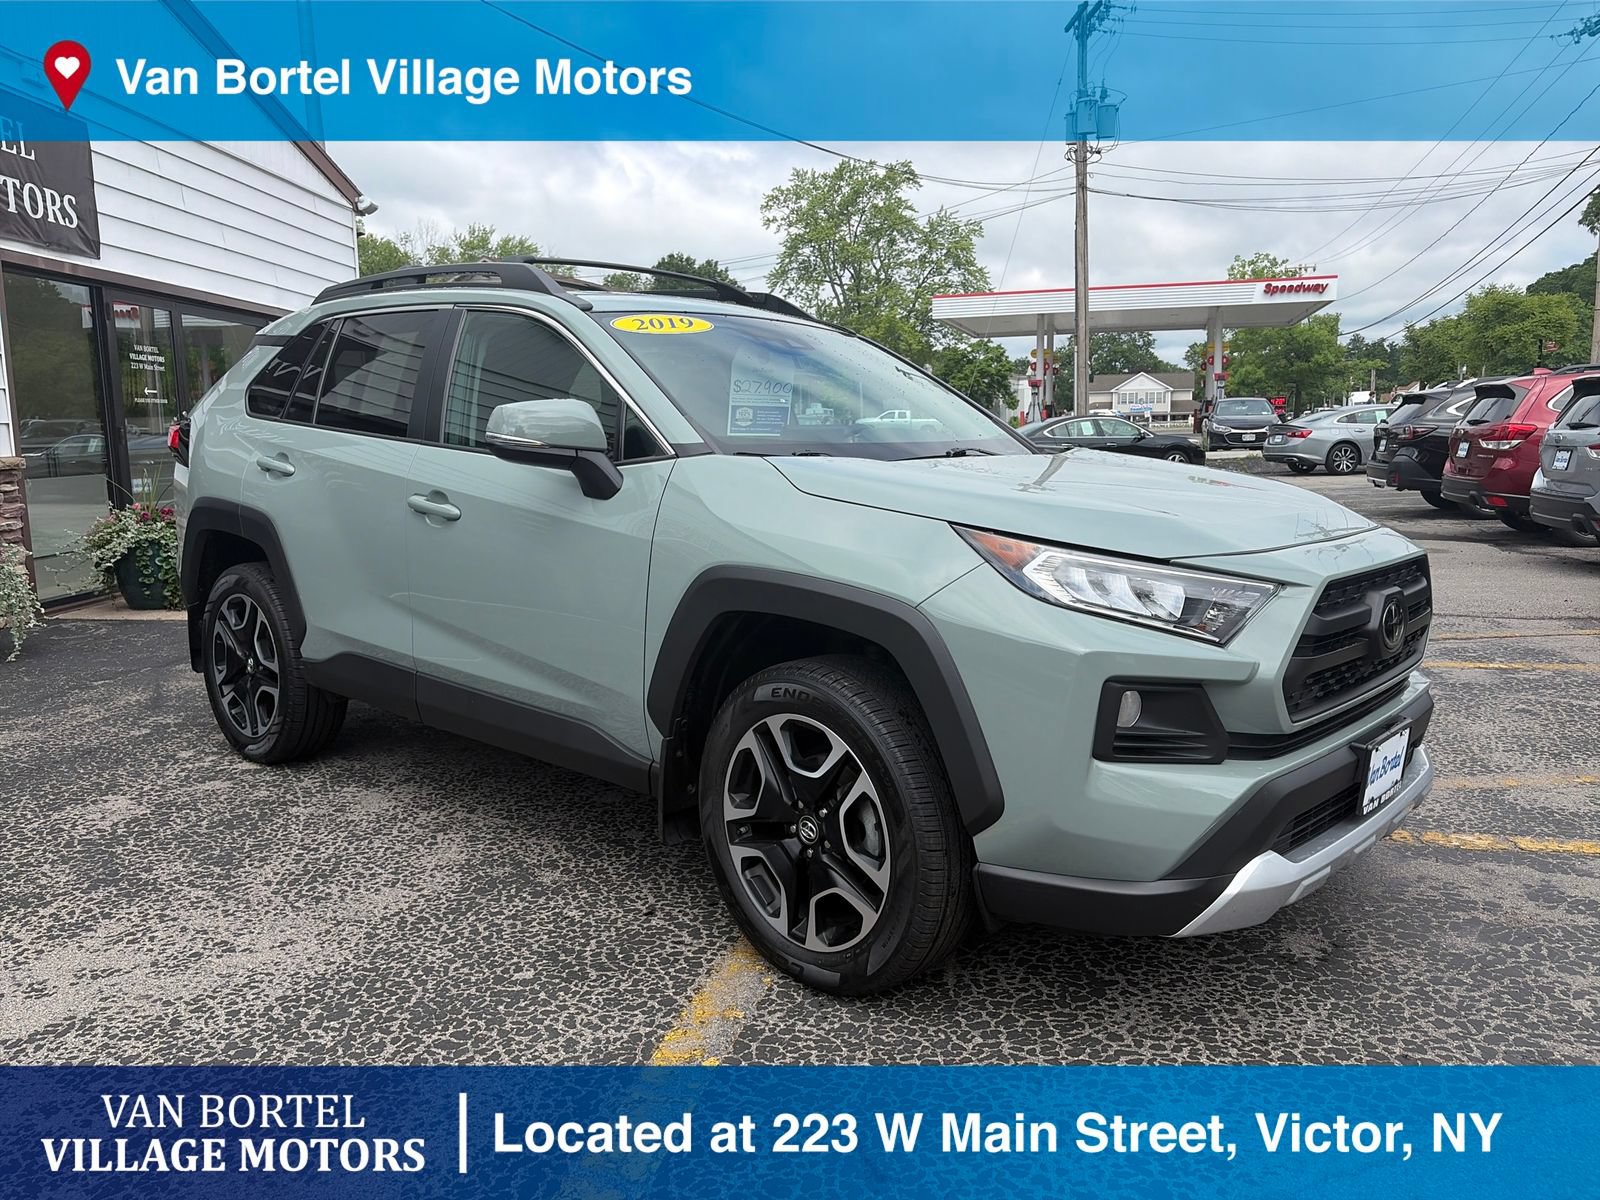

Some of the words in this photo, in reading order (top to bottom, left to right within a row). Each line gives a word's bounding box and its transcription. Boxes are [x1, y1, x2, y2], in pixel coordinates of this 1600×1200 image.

[1263, 281, 1329, 296] Speedway
[631, 317, 694, 331] 2019
[1363, 798, 1379, 815] VAN
